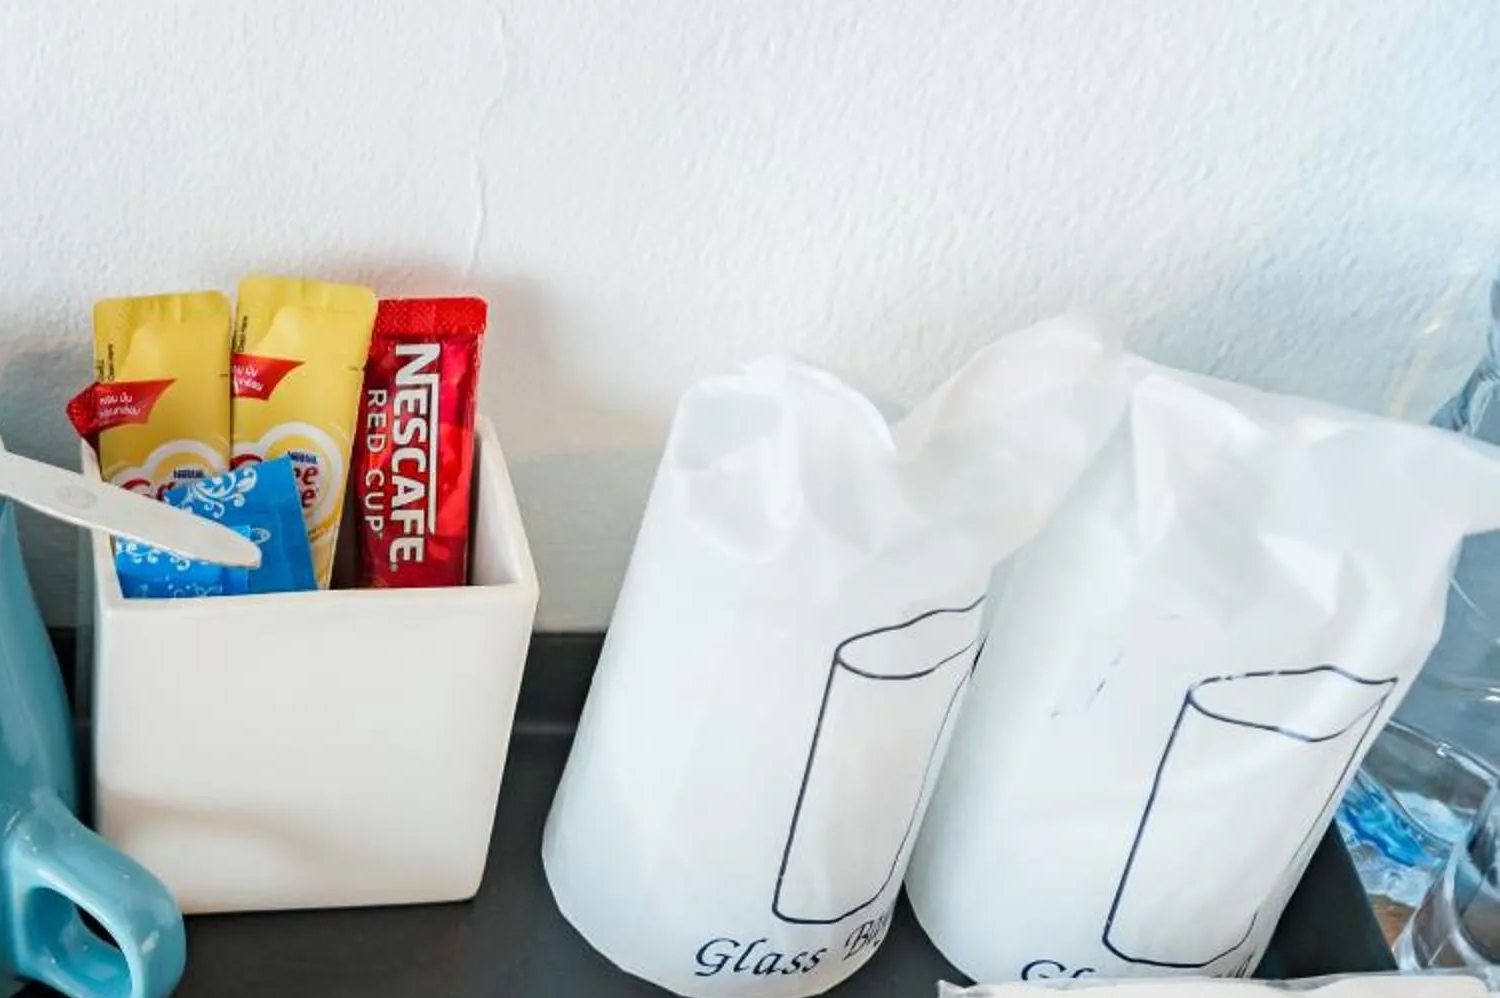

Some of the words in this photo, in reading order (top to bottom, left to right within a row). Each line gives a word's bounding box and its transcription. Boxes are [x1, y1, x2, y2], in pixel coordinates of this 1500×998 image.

[365, 389, 388, 451] RED
[363, 469, 386, 533] CUP
[694, 938, 828, 977] Glass
